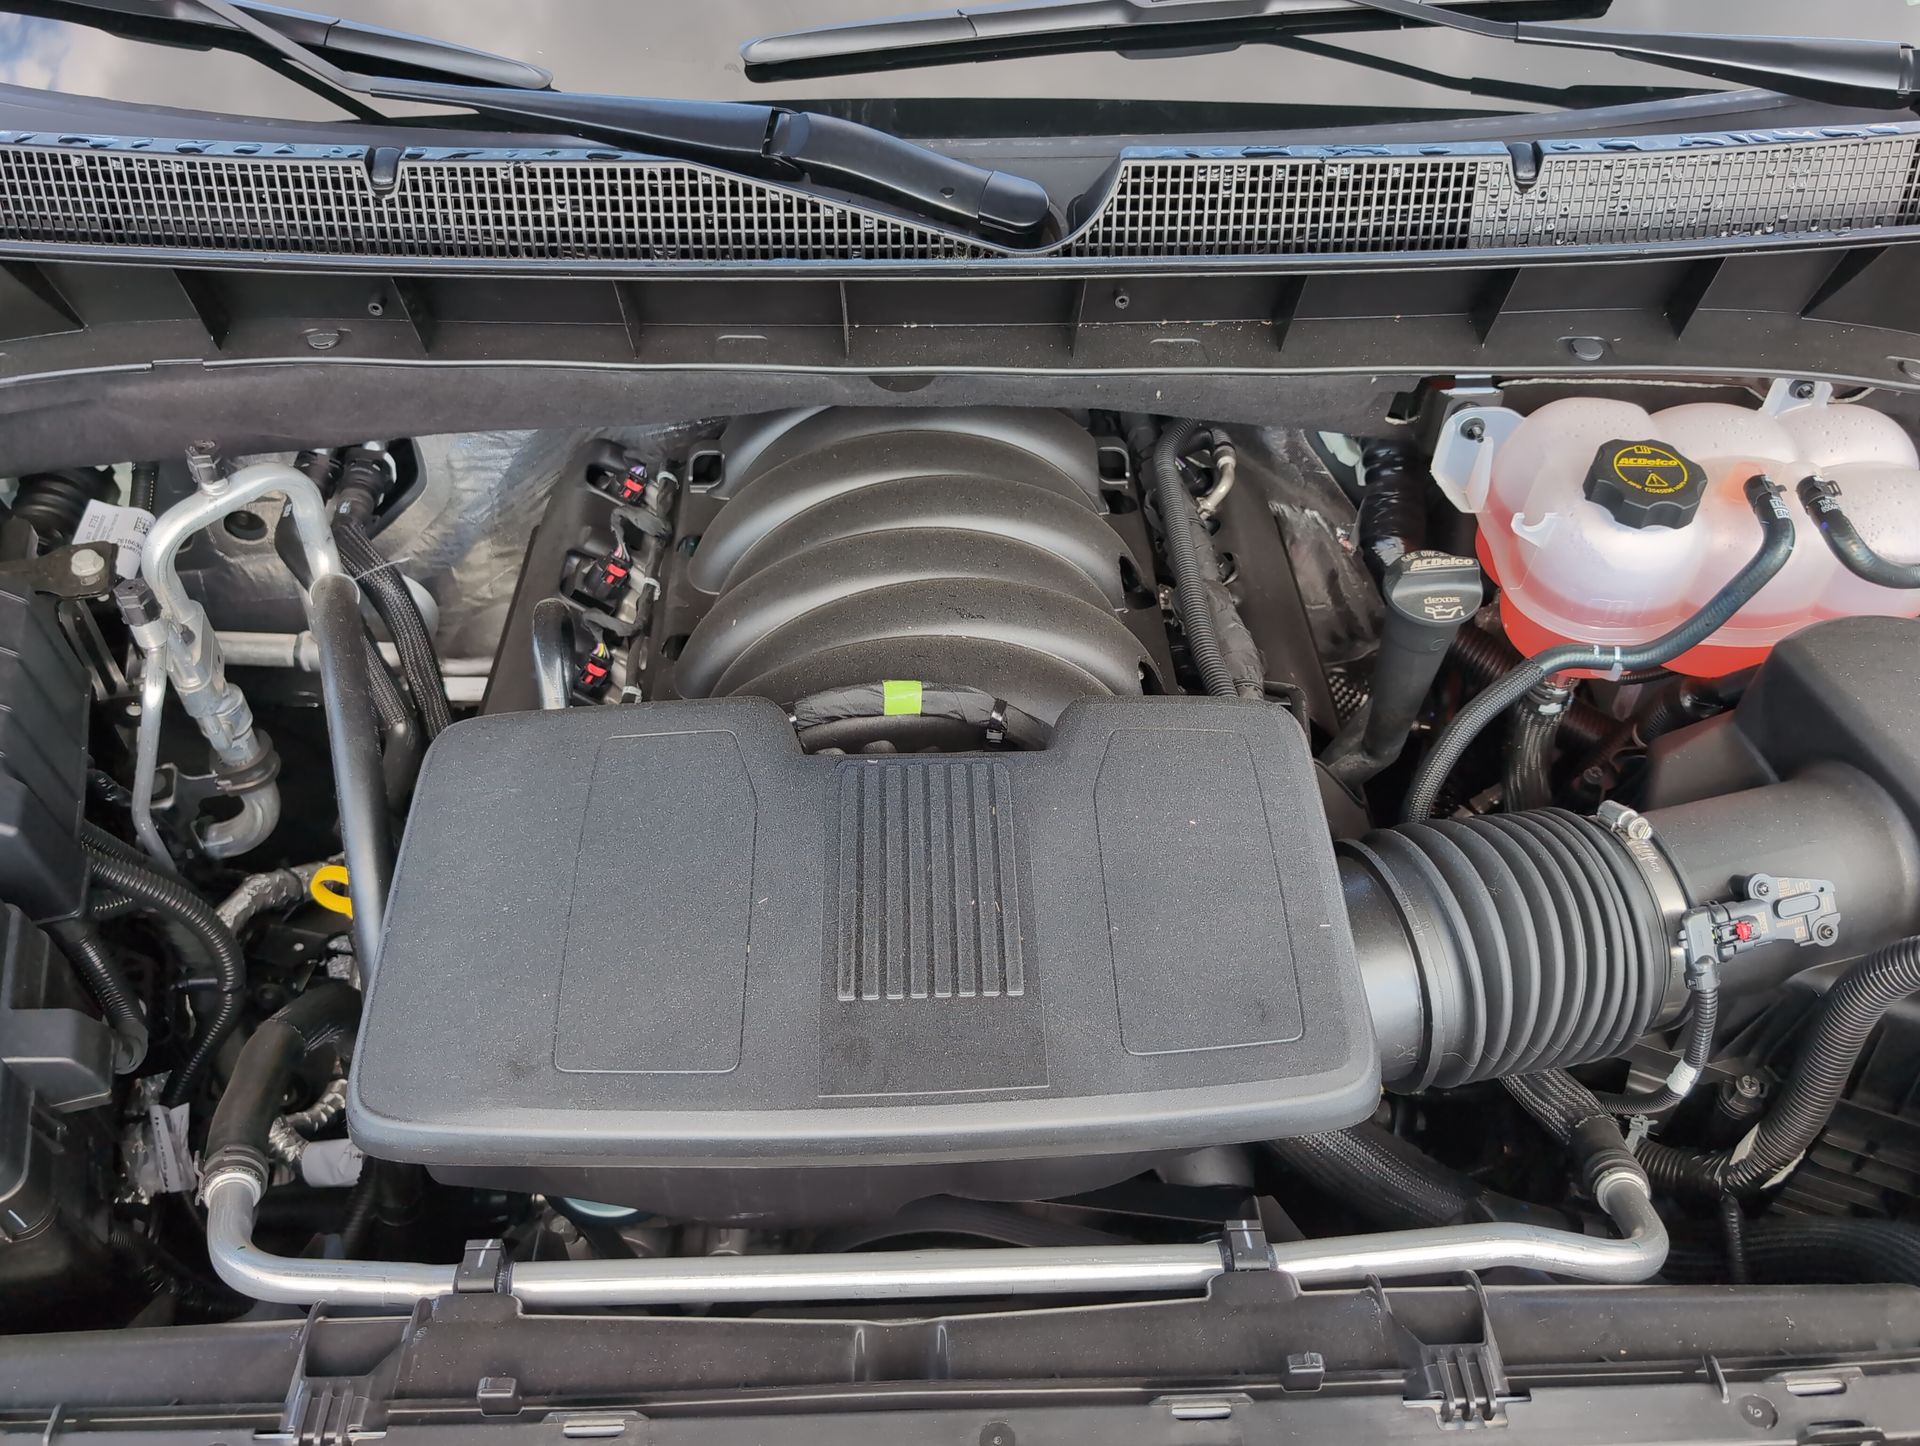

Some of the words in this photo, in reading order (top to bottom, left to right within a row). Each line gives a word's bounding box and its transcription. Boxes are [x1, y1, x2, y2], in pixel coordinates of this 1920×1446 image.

[1618, 457, 1678, 465] ACDelco
[1401, 551, 1418, 562] SAE
[1410, 557, 1474, 569] ACDelco
[1424, 596, 1461, 604] dexos
